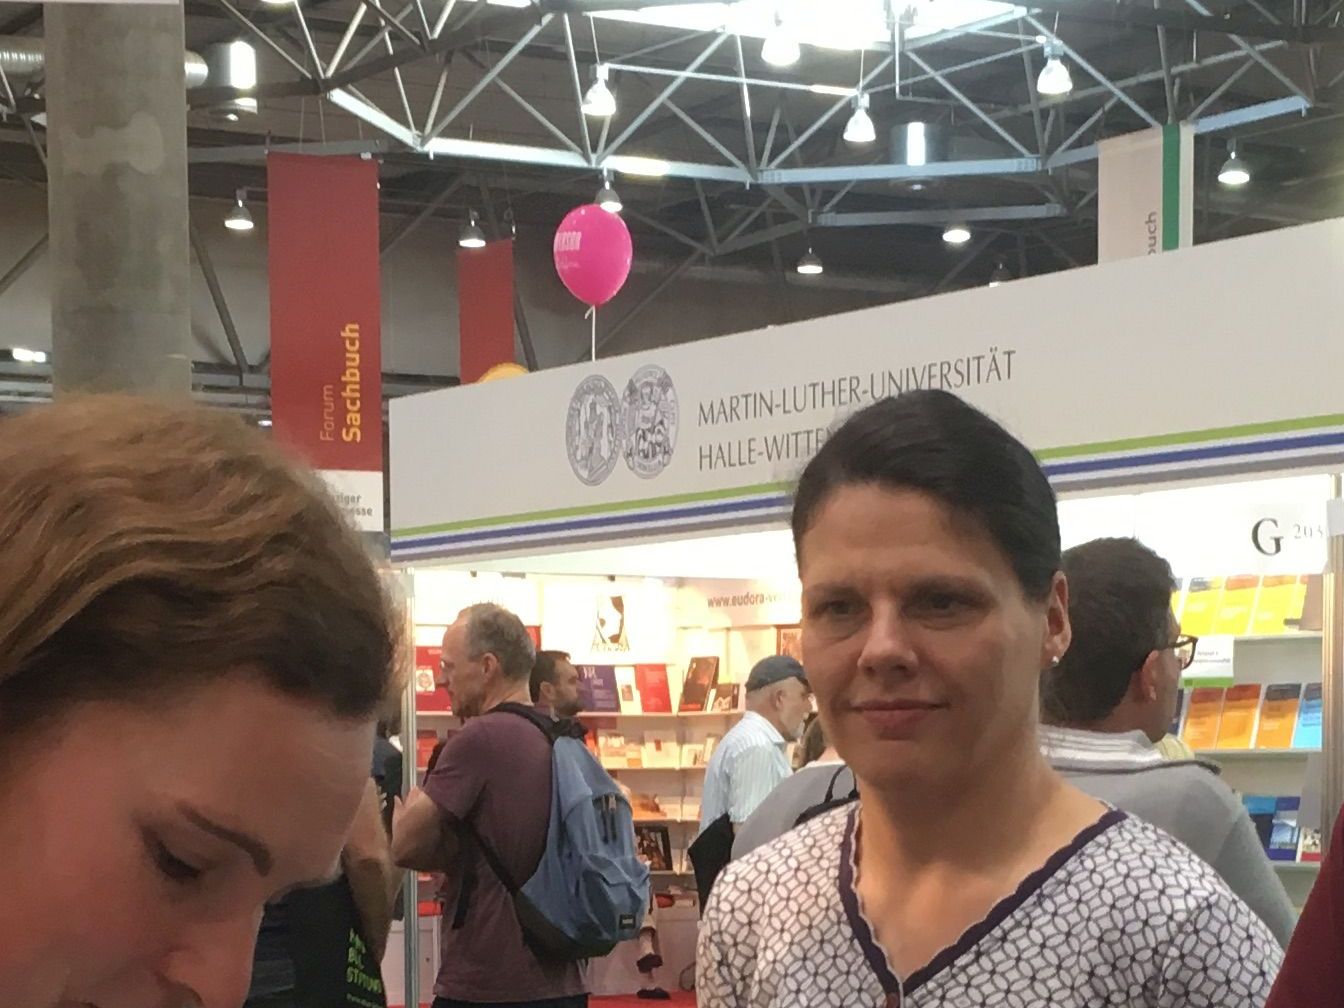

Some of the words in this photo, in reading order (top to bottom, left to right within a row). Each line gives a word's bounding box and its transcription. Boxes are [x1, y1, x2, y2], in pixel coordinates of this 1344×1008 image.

[320, 384, 336, 442] Forum
[342, 323, 362, 443] Sachbuch
[698, 346, 1016, 427] MARTIN-LUTHER-UNIVERSITÄT
[1251, 517, 1284, 556] G
